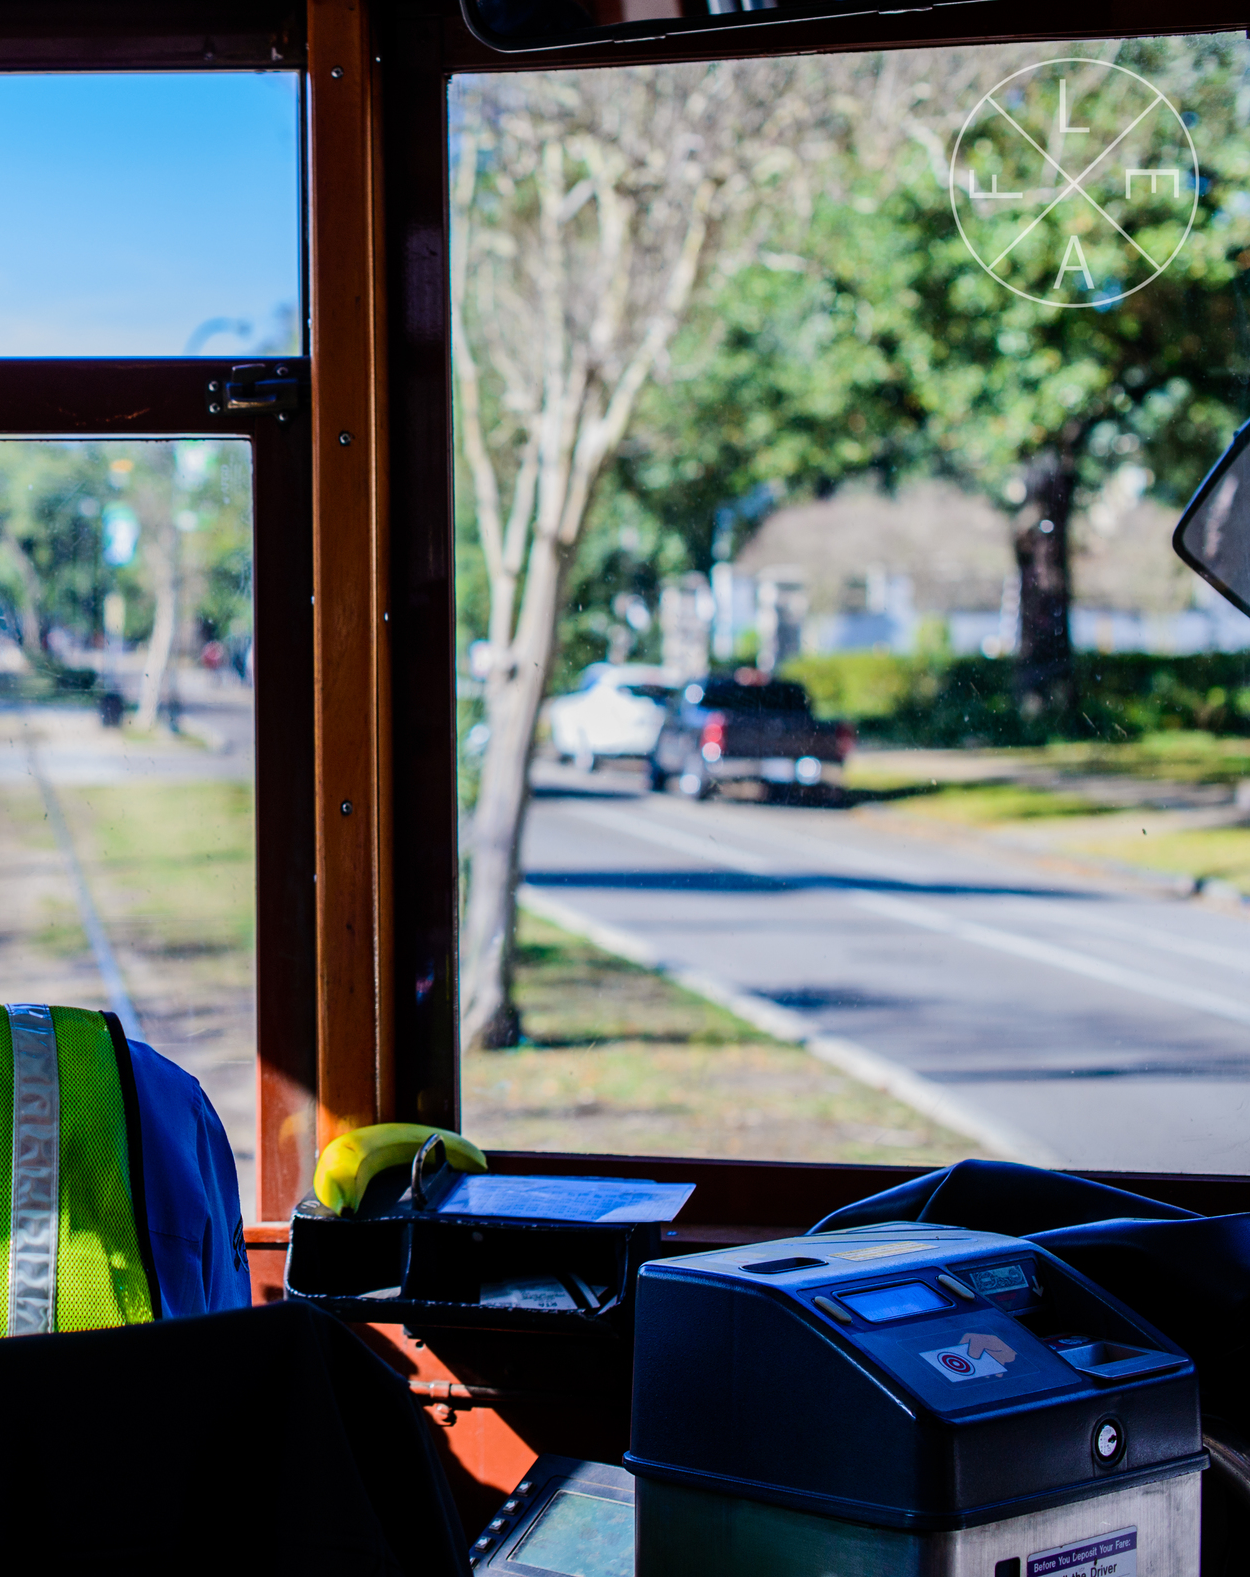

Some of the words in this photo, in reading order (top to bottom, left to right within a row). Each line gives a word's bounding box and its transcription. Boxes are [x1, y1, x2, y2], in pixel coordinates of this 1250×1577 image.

[1034, 1560, 1056, 1573] Before
[1058, 1555, 1070, 1566] You
[1072, 1548, 1098, 1562] Deposit
[1099, 1543, 1113, 1554] Your
[1115, 1539, 1131, 1550] Fare:
[1090, 1563, 1117, 1577] Driver
